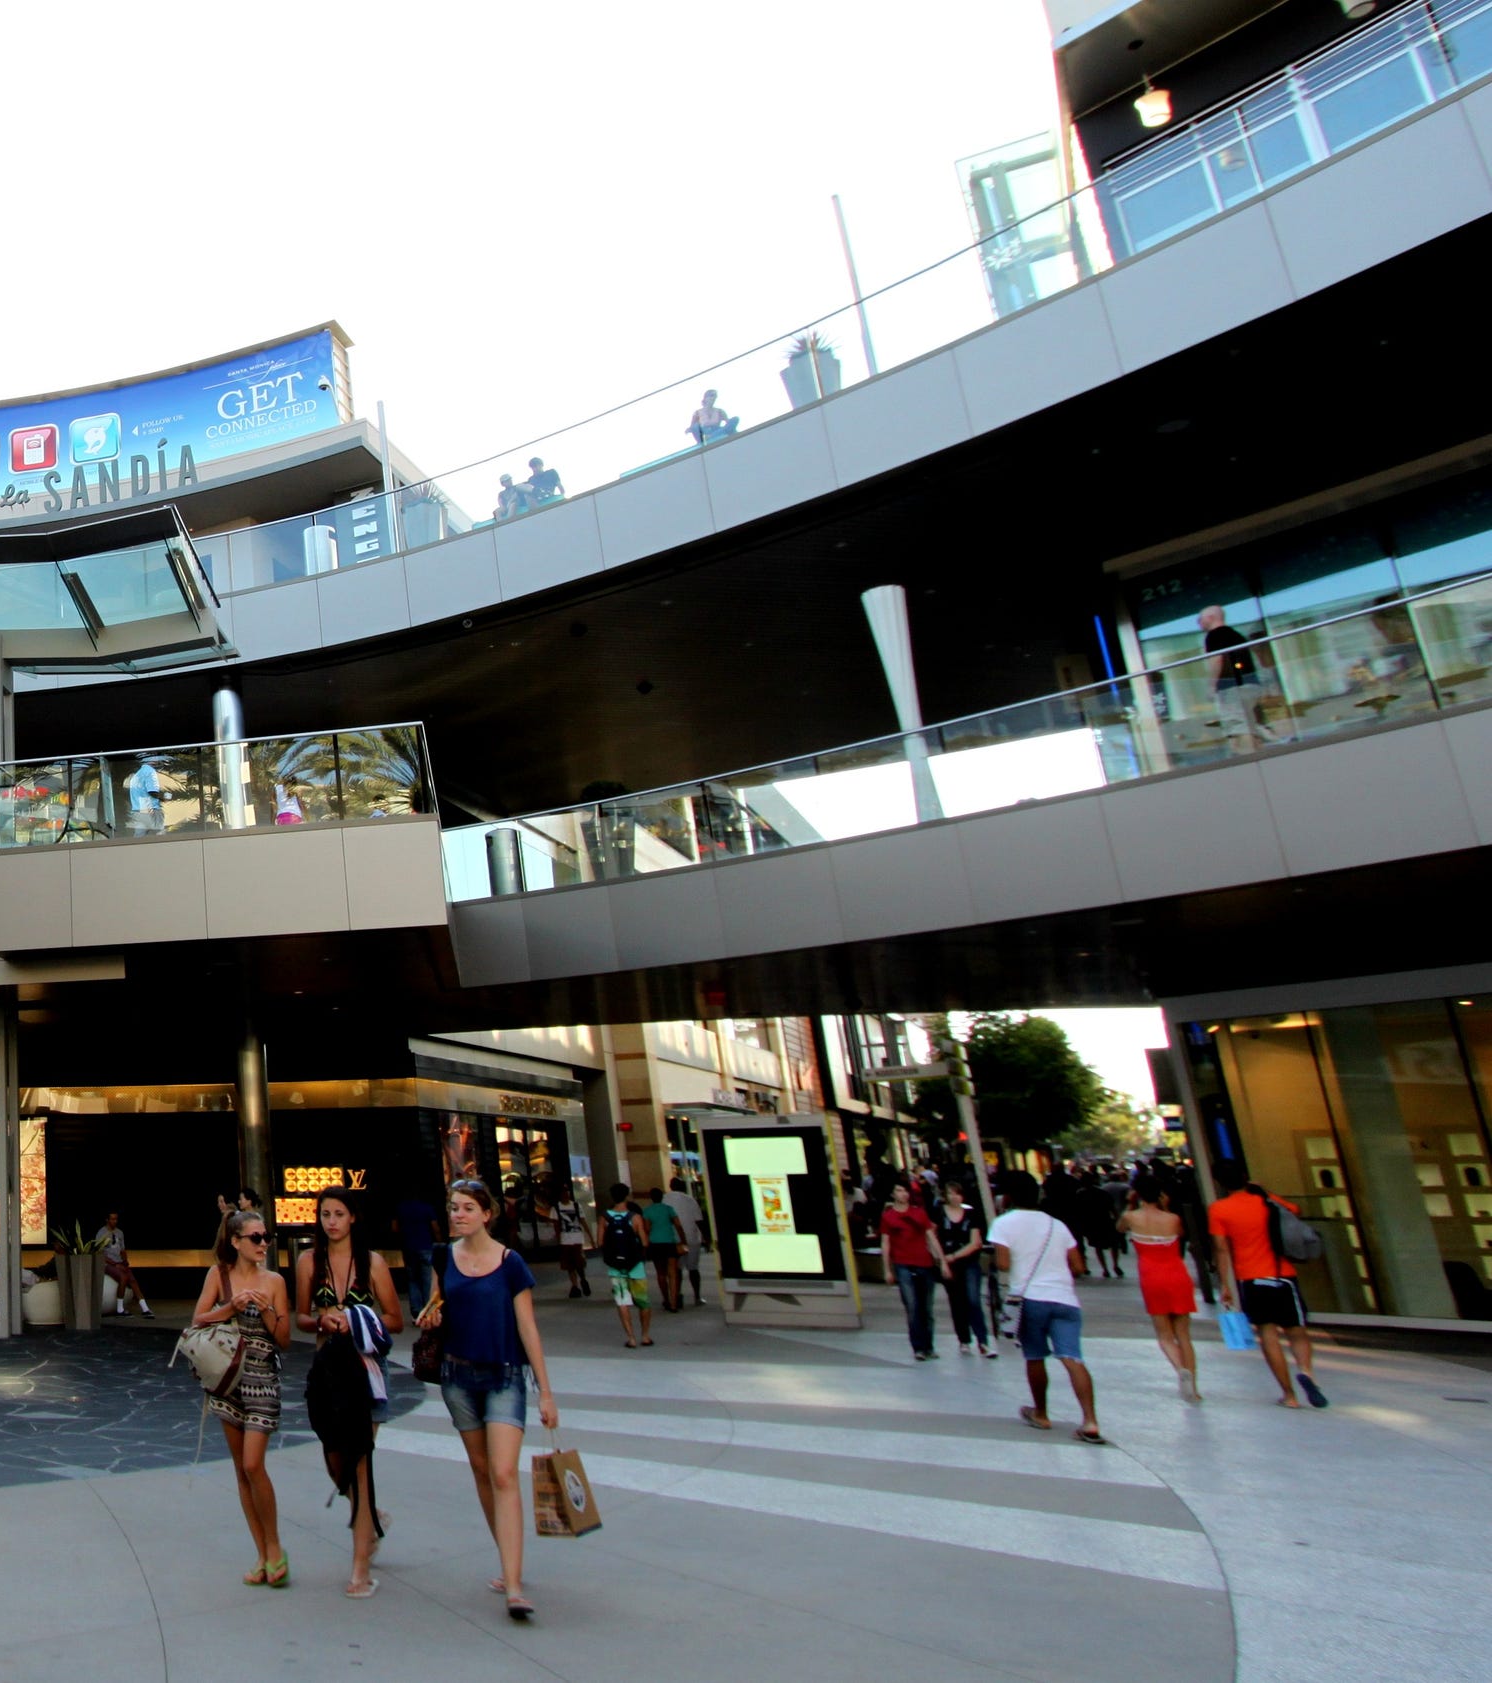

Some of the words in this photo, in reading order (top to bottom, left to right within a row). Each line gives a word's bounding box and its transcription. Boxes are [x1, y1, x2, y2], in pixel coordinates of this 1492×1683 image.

[217, 371, 303, 420] GET
[142, 417, 172, 428] FOLLOW
[205, 399, 317, 439] CONNECTED
[350, 487, 381, 564] ZENG
